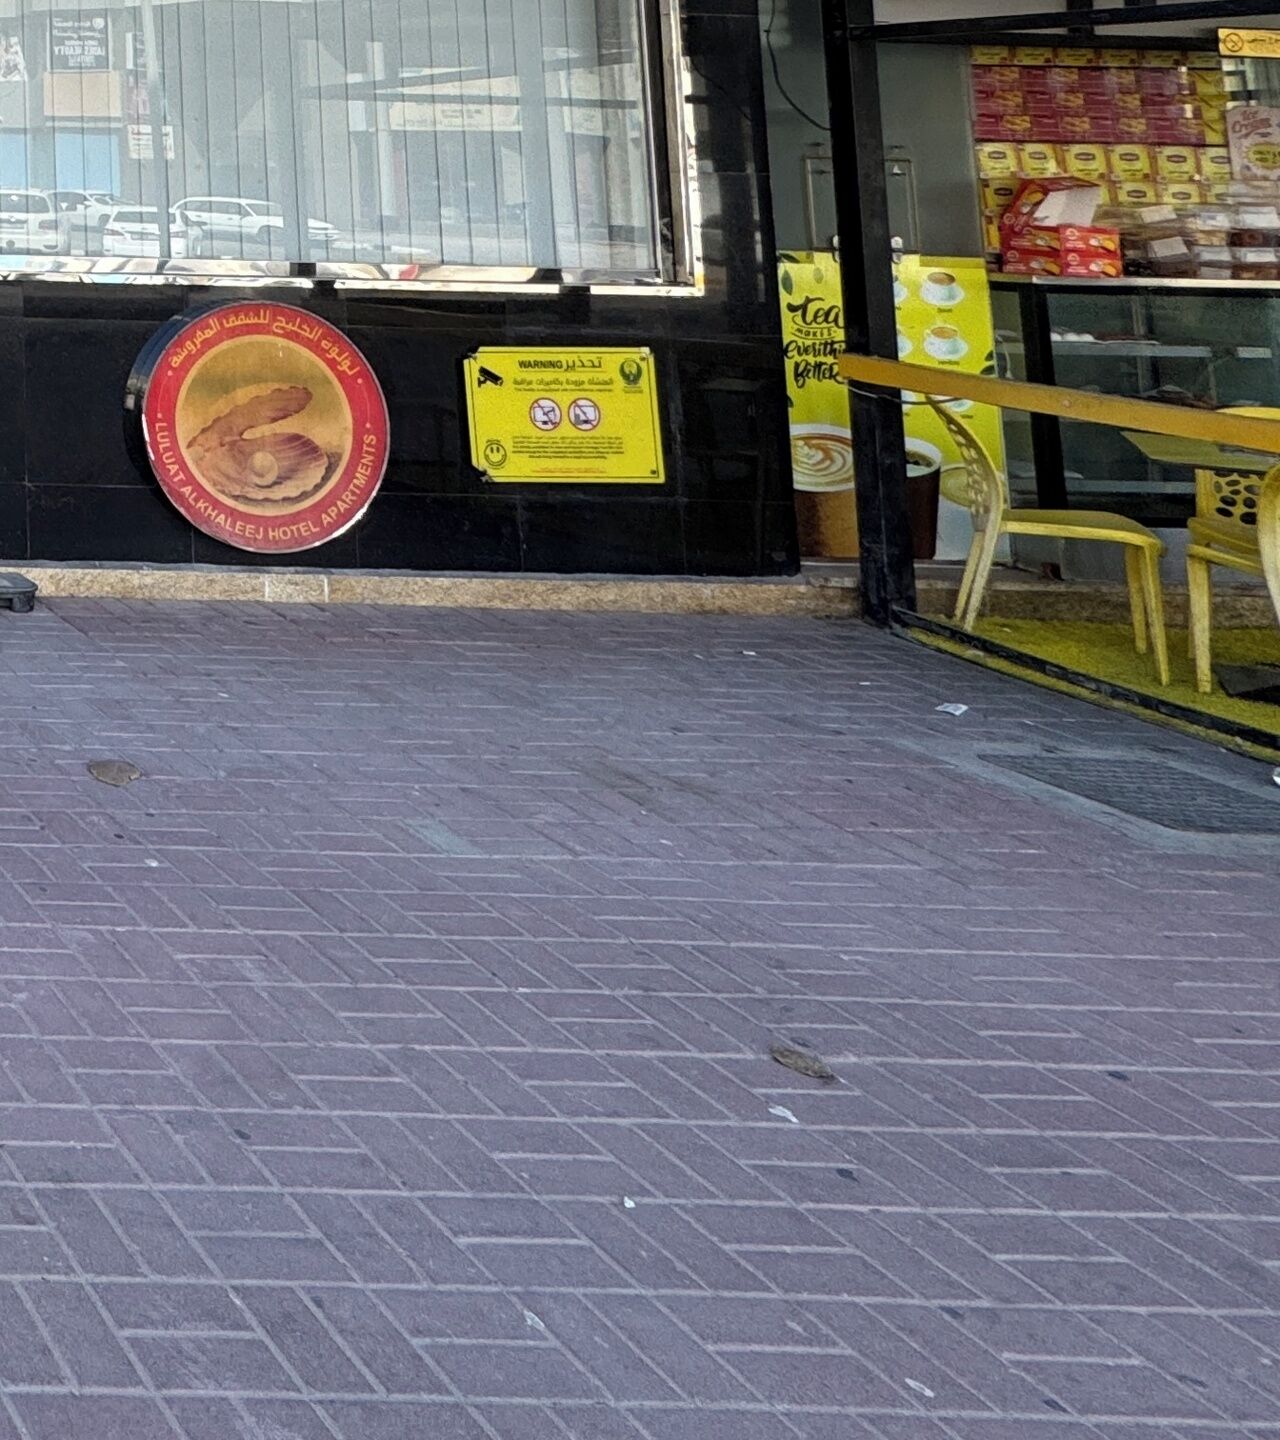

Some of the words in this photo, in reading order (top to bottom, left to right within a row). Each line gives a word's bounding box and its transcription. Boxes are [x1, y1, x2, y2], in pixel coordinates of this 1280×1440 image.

[786, 295, 845, 329] tea
[272, 316, 323, 342] الخليج
[517, 359, 563, 369] WARNING
[564, 354, 603, 372] تحذير
[154, 421, 186, 483] LULUAT
[180, 485, 264, 541] ALKHALEEJ
[268, 520, 321, 541] HOTEL
[319, 433, 378, 529] APARTMENTS
